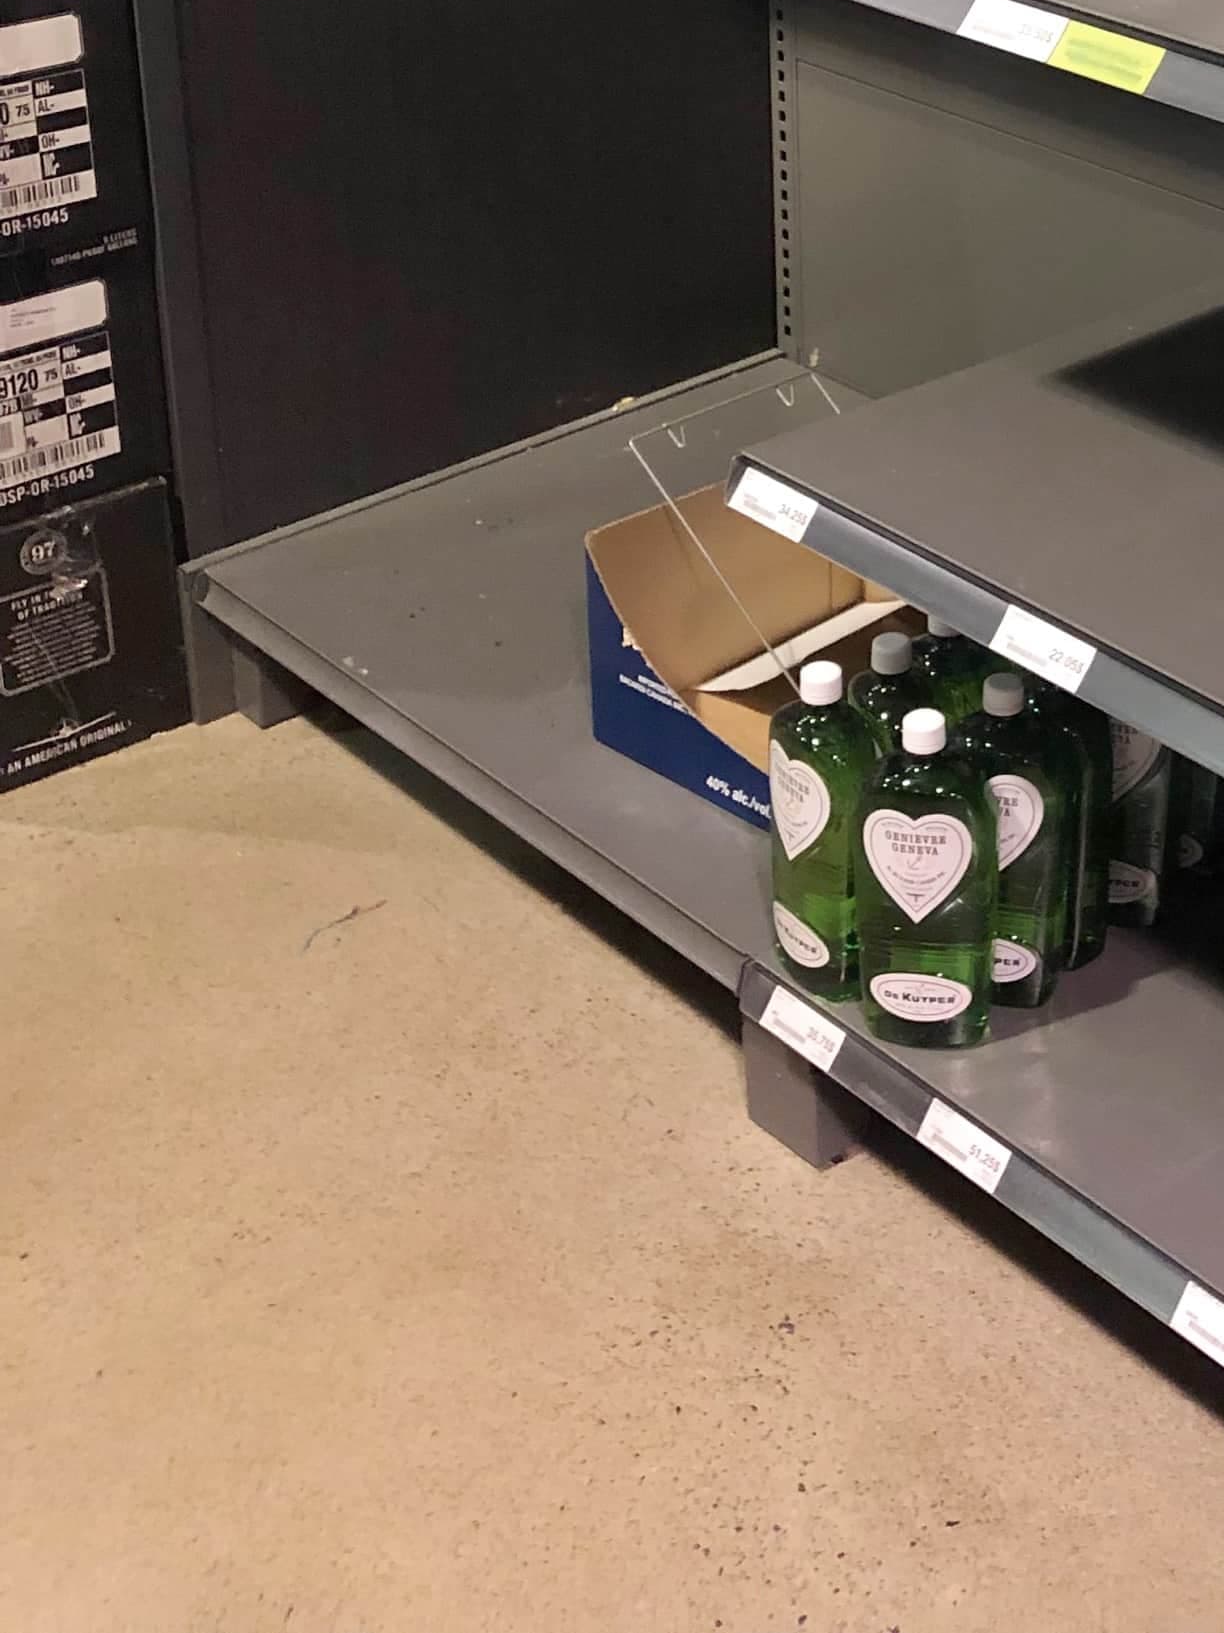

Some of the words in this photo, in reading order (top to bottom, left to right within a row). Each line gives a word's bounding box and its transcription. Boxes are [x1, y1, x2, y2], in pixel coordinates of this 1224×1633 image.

[16, 103, 31, 117] 75
[45, 368, 58, 383] 75
[31, 539, 56, 562] 97
[7, 759, 22, 776] AN
[24, 738, 78, 768] AMERICAN
[80, 720, 126, 748] ORIGINAL
[706, 774, 731, 797] 40%
[892, 842, 939, 856] GENEVA
